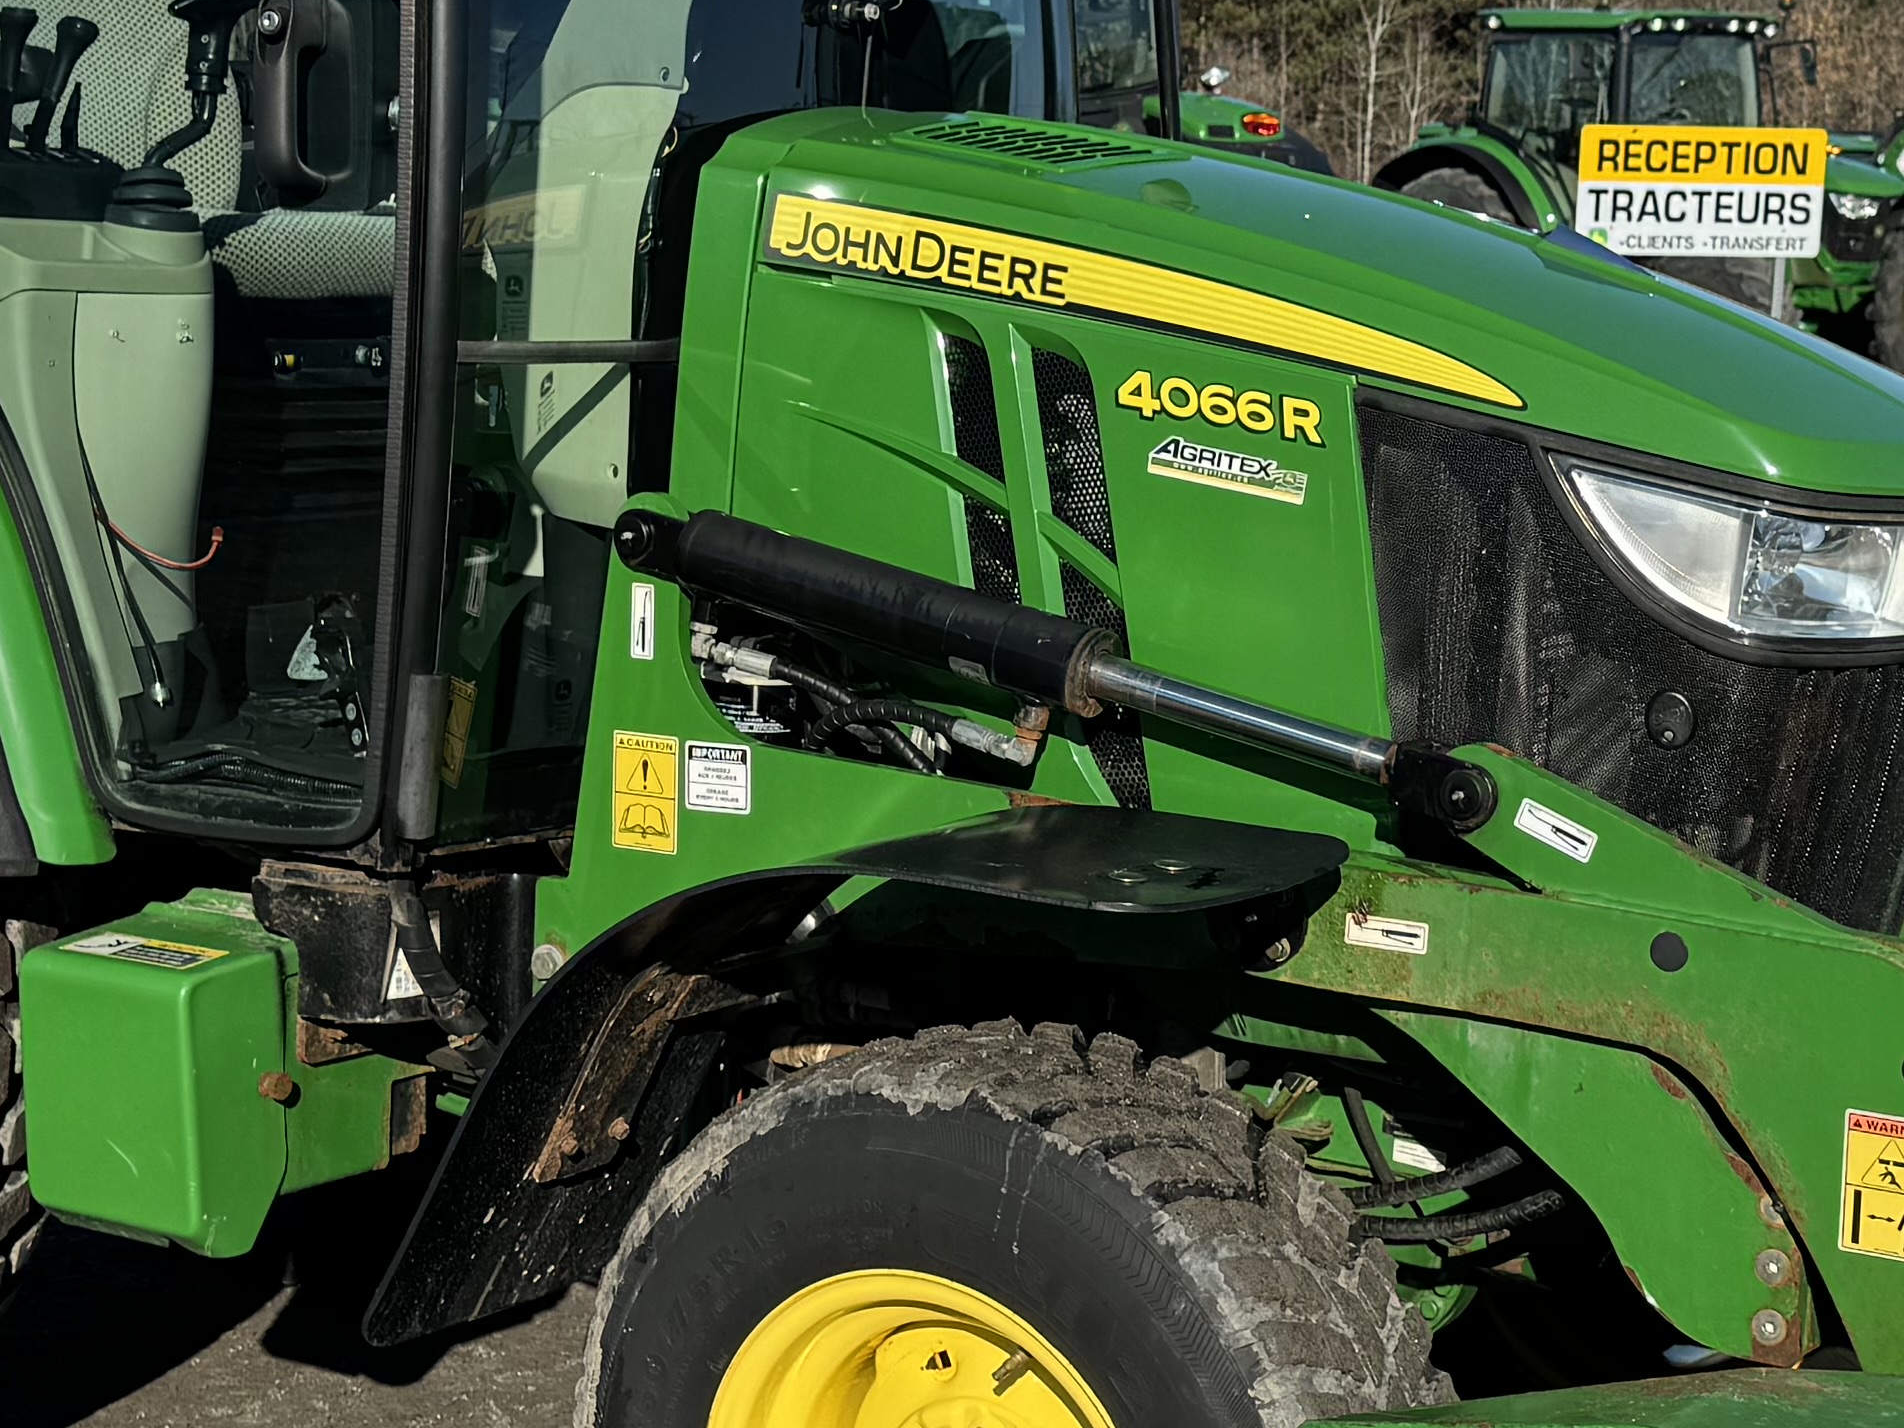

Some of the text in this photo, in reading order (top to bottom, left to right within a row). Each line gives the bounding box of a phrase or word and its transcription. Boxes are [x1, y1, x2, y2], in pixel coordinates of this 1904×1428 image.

[1588, 188, 1812, 225] TRACTEURS
[784, 210, 1069, 300] JOHN DEERE
[1153, 438, 1274, 478] AGRITEX
[626, 738, 674, 752] CAUTION
